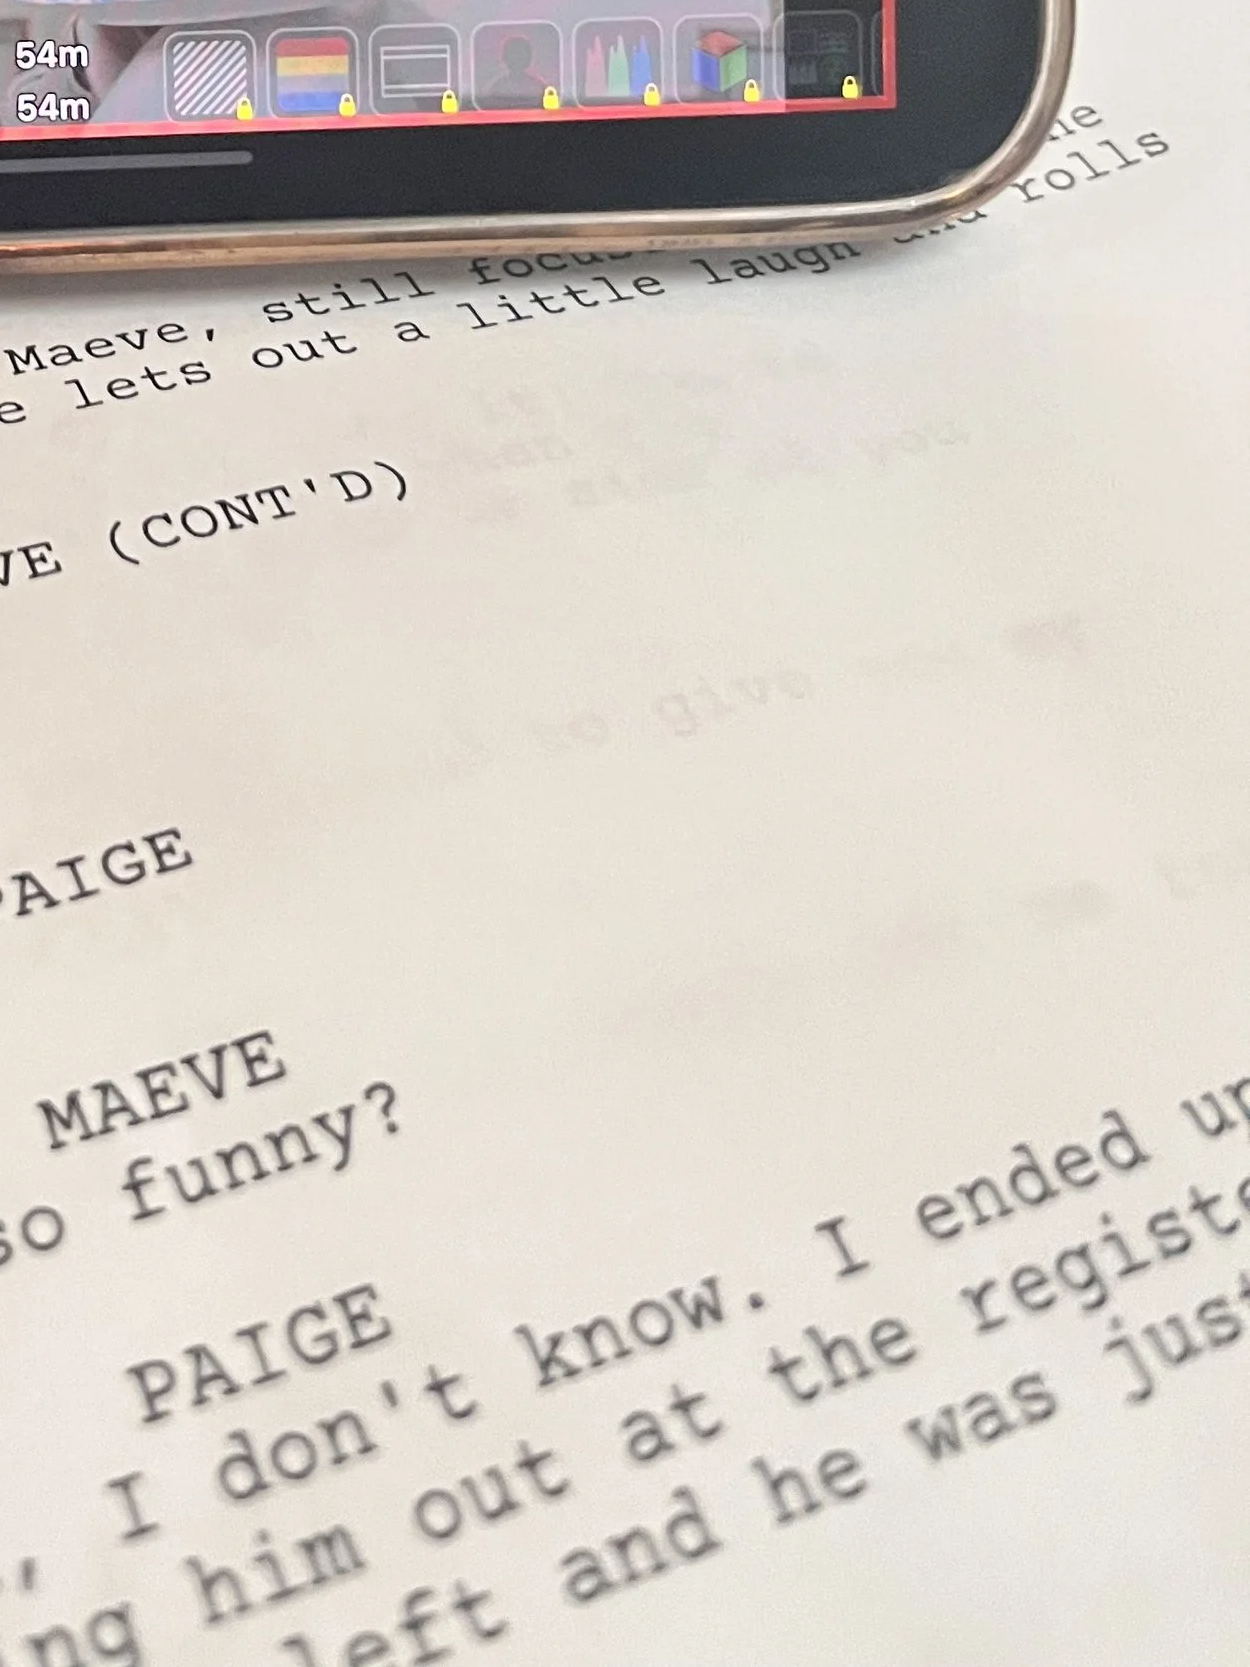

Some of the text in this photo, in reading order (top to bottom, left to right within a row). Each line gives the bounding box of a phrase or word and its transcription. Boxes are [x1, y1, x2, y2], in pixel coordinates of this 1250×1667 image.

[14, 38, 90, 71] 54m
[16, 91, 91, 123] 54m
[2, 322, 215, 376] Maeve,
[261, 271, 435, 324] still
[63, 360, 212, 411] lets
[251, 330, 358, 370] out
[394, 320, 431, 343] a
[456, 274, 666, 330] little
[1009, 131, 1170, 204] rolls
[108, 460, 408, 566] (CONT'D)
[35, 1029, 288, 1152] MAEVE
[121, 1081, 401, 1223] funny?
[105, 1471, 160, 1543] I
[216, 1365, 479, 1504] don't
[512, 1275, 766, 1390] know.
[813, 1215, 871, 1280] I
[915, 1109, 1152, 1242] ended
[125, 1283, 393, 1426] PAIGE
[184, 1524, 367, 1626] him
[412, 1441, 571, 1543] out
[620, 1383, 725, 1465] at
[766, 1317, 919, 1405] the
[560, 1485, 723, 1605] and
[750, 1449, 869, 1526] he
[904, 1370, 1059, 1462] was
[1103, 1272, 1250, 1404] jus
